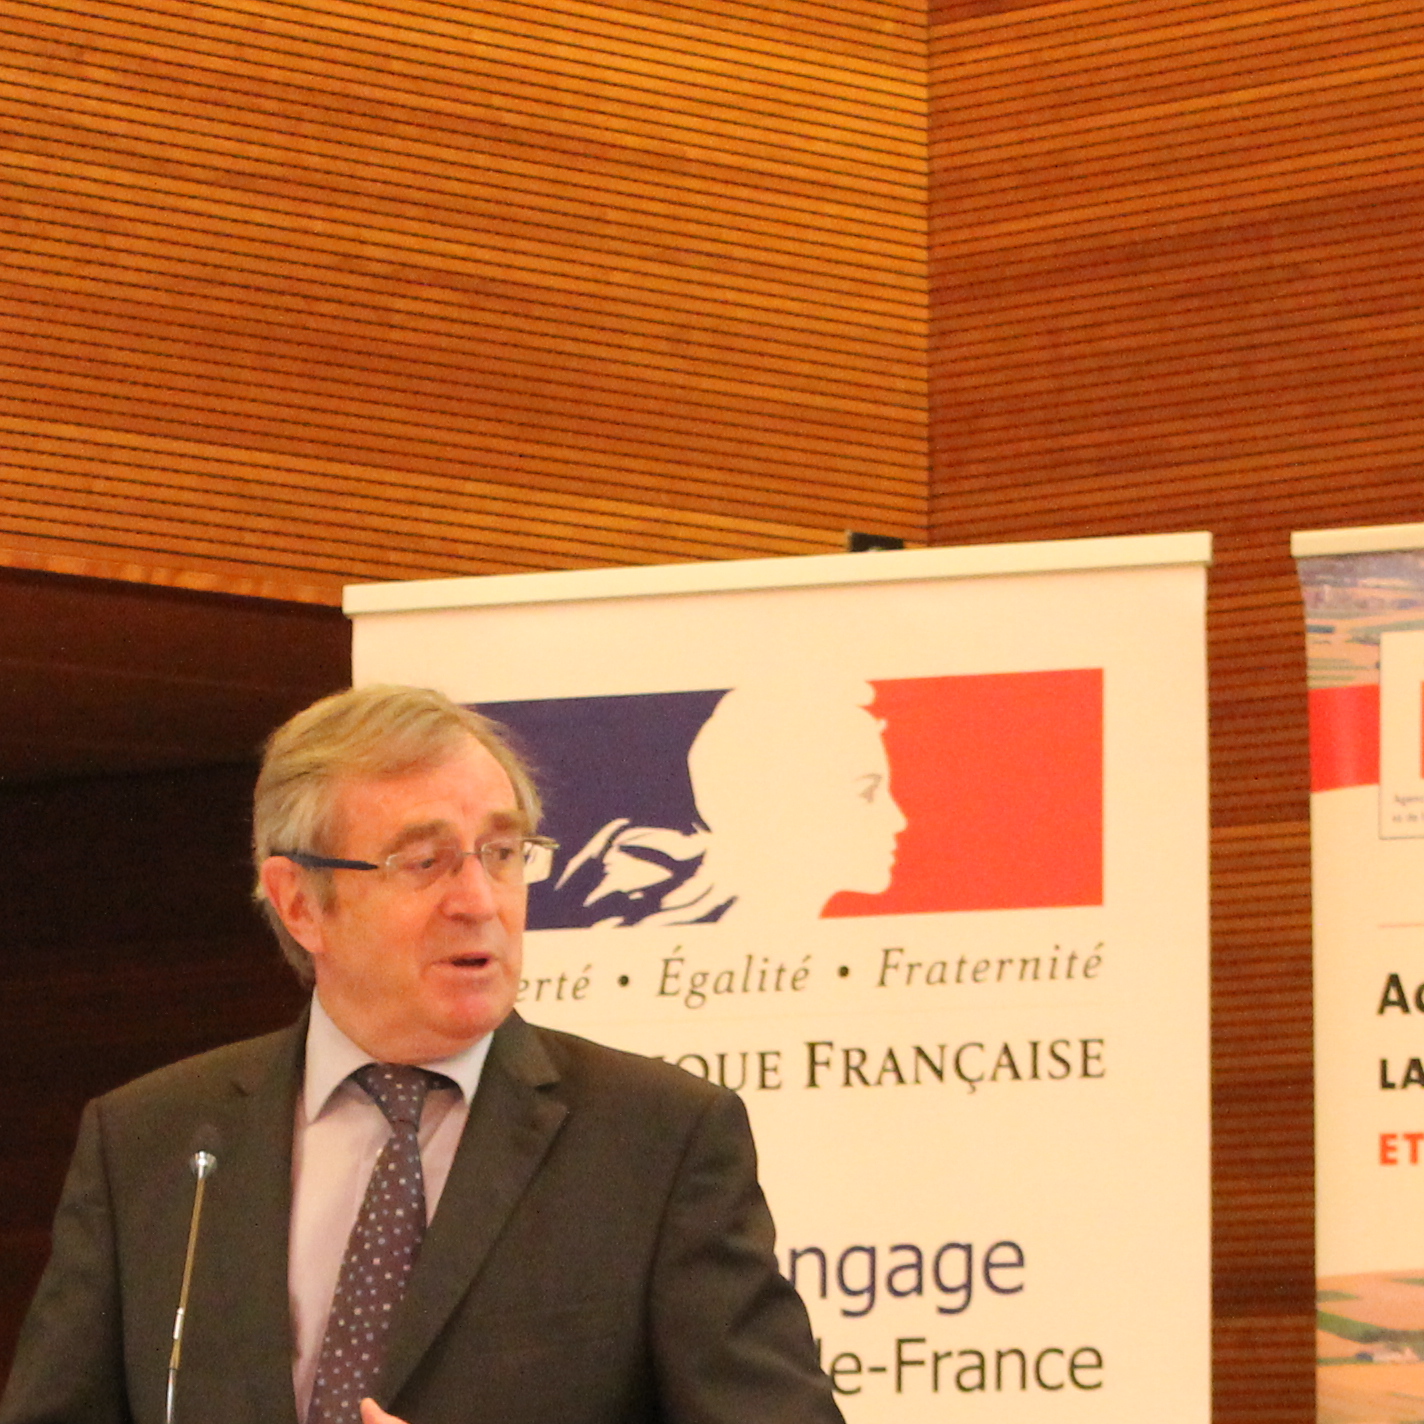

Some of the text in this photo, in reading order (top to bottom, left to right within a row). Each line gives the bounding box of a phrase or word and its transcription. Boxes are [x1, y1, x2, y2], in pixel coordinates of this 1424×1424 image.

[517, 942, 1106, 1010] erté Égalité Fraternité
[805, 1038, 1106, 1097] FRANÇAISE
[788, 1240, 1025, 1319] ngage
[816, 1337, 1104, 1396] e-France
